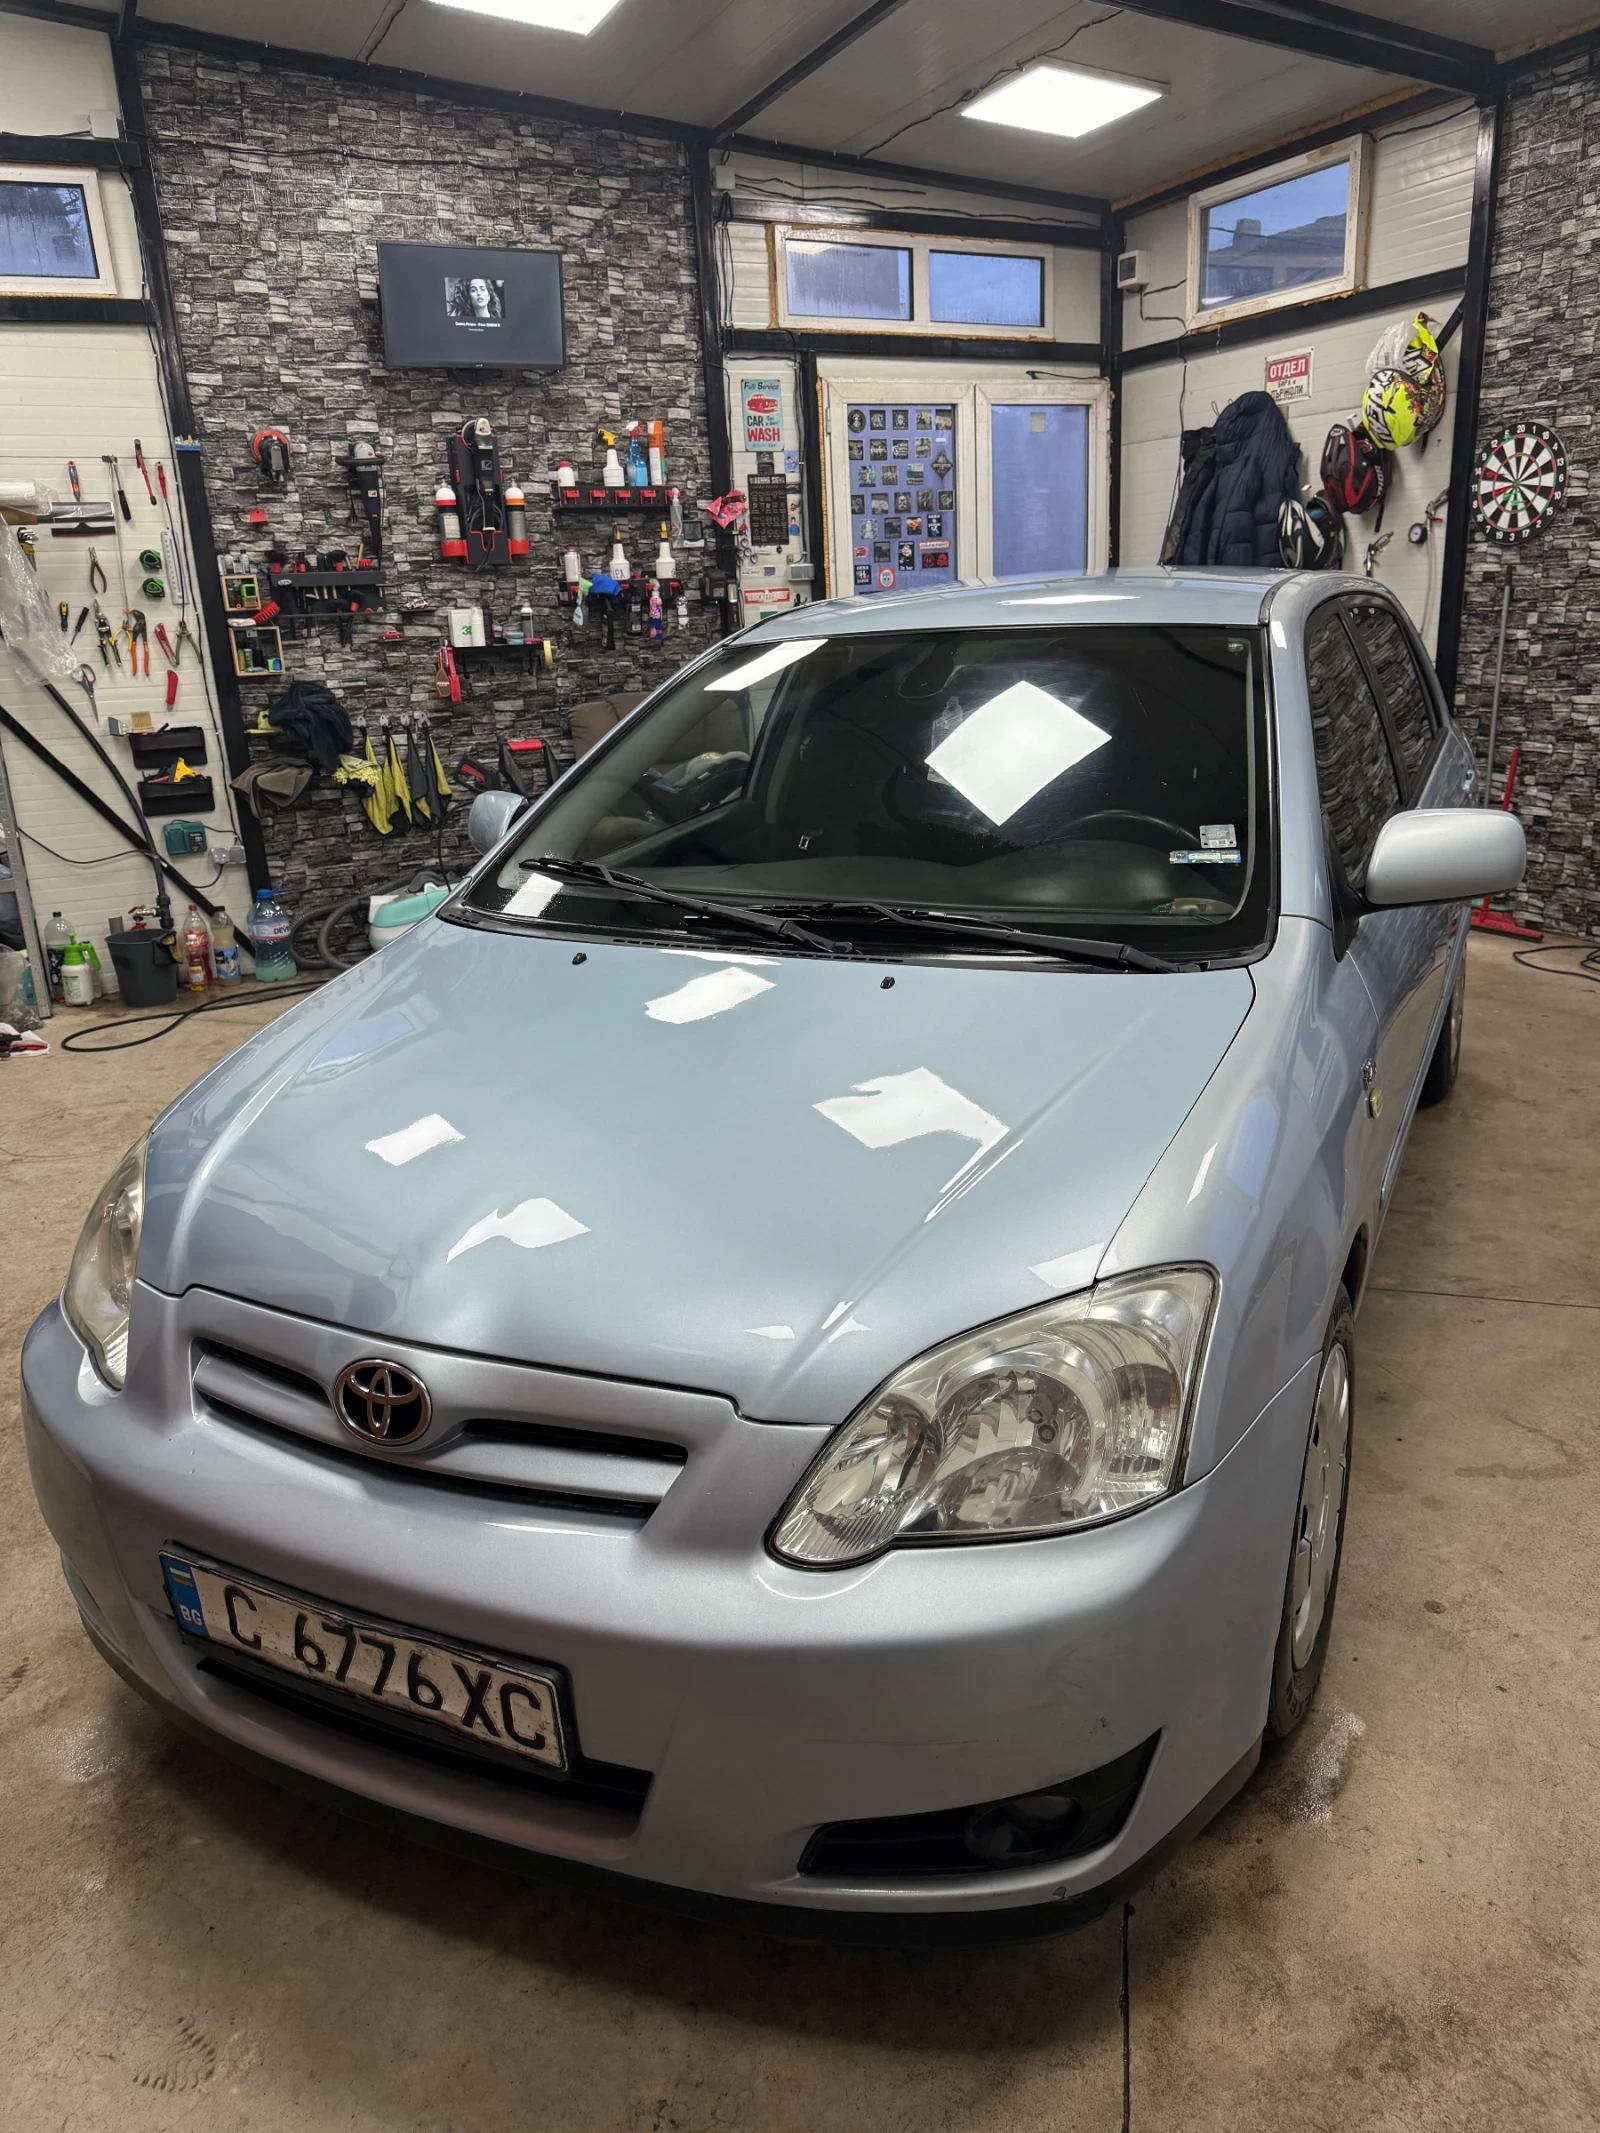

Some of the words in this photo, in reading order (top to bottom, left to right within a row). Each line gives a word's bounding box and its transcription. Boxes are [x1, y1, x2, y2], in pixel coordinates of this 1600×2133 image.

[1269, 358, 1307, 378] ОТДЕЛ
[744, 382, 756, 390] Full
[757, 382, 779, 390] Service
[747, 415, 764, 427] CAR
[1516, 424, 1526, 433] 20
[746, 427, 781, 442] WASH
[1542, 431, 1550, 440] 18
[1490, 439, 1498, 448] 12
[1552, 442, 1558, 450] 4
[1482, 452, 1487, 460] 9
[1556, 458, 1564, 466] 13
[1474, 467, 1482, 476] 14
[1558, 474, 1564, 482] 6
[1554, 492, 1562, 500] 10
[1472, 500, 1478, 508] 8
[1546, 507, 1554, 516] 15
[1486, 525, 1491, 534] 7
[1522, 529, 1530, 538] 17
[1496, 531, 1504, 540] 19
[1509, 532, 1515, 541] 3
[179, 1604, 203, 1626] BG
